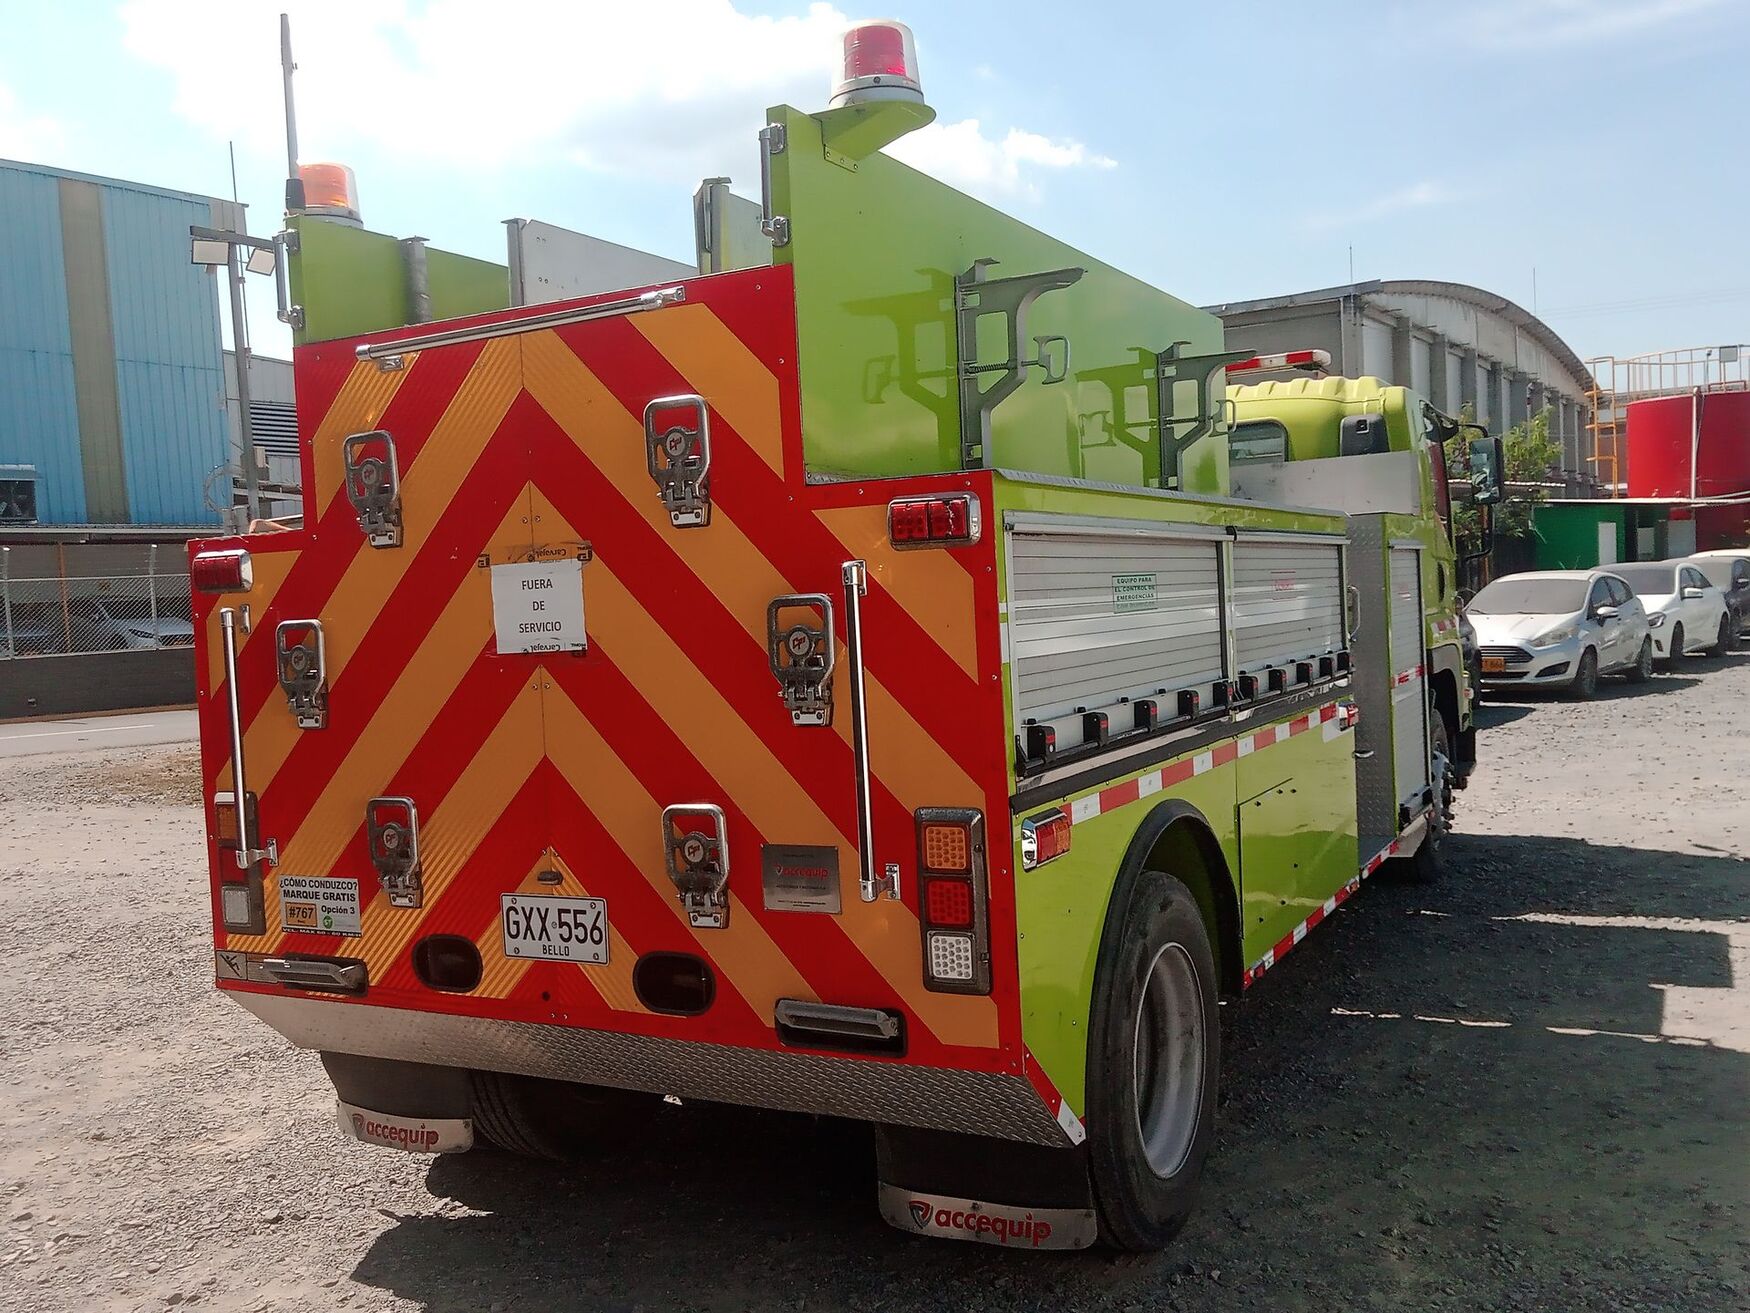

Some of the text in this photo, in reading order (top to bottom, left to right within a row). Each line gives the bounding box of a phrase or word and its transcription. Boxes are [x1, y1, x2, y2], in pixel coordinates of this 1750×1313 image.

[522, 578, 553, 590] FUERA
[1117, 593, 1154, 601] EMERGENCIAS
[532, 600, 545, 611] DE
[519, 621, 562, 634] SERVICIO
[279, 877, 358, 890] ¿CÓMO CONDUZCO?
[283, 889, 356, 902] MARQUE GRATIS
[289, 905, 355, 919] #767 Opción 3
[505, 905, 603, 945] GXX 556
[542, 944, 570, 956] BELLO
[366, 1120, 440, 1151] accequip
[934, 1209, 1052, 1247] accequip
